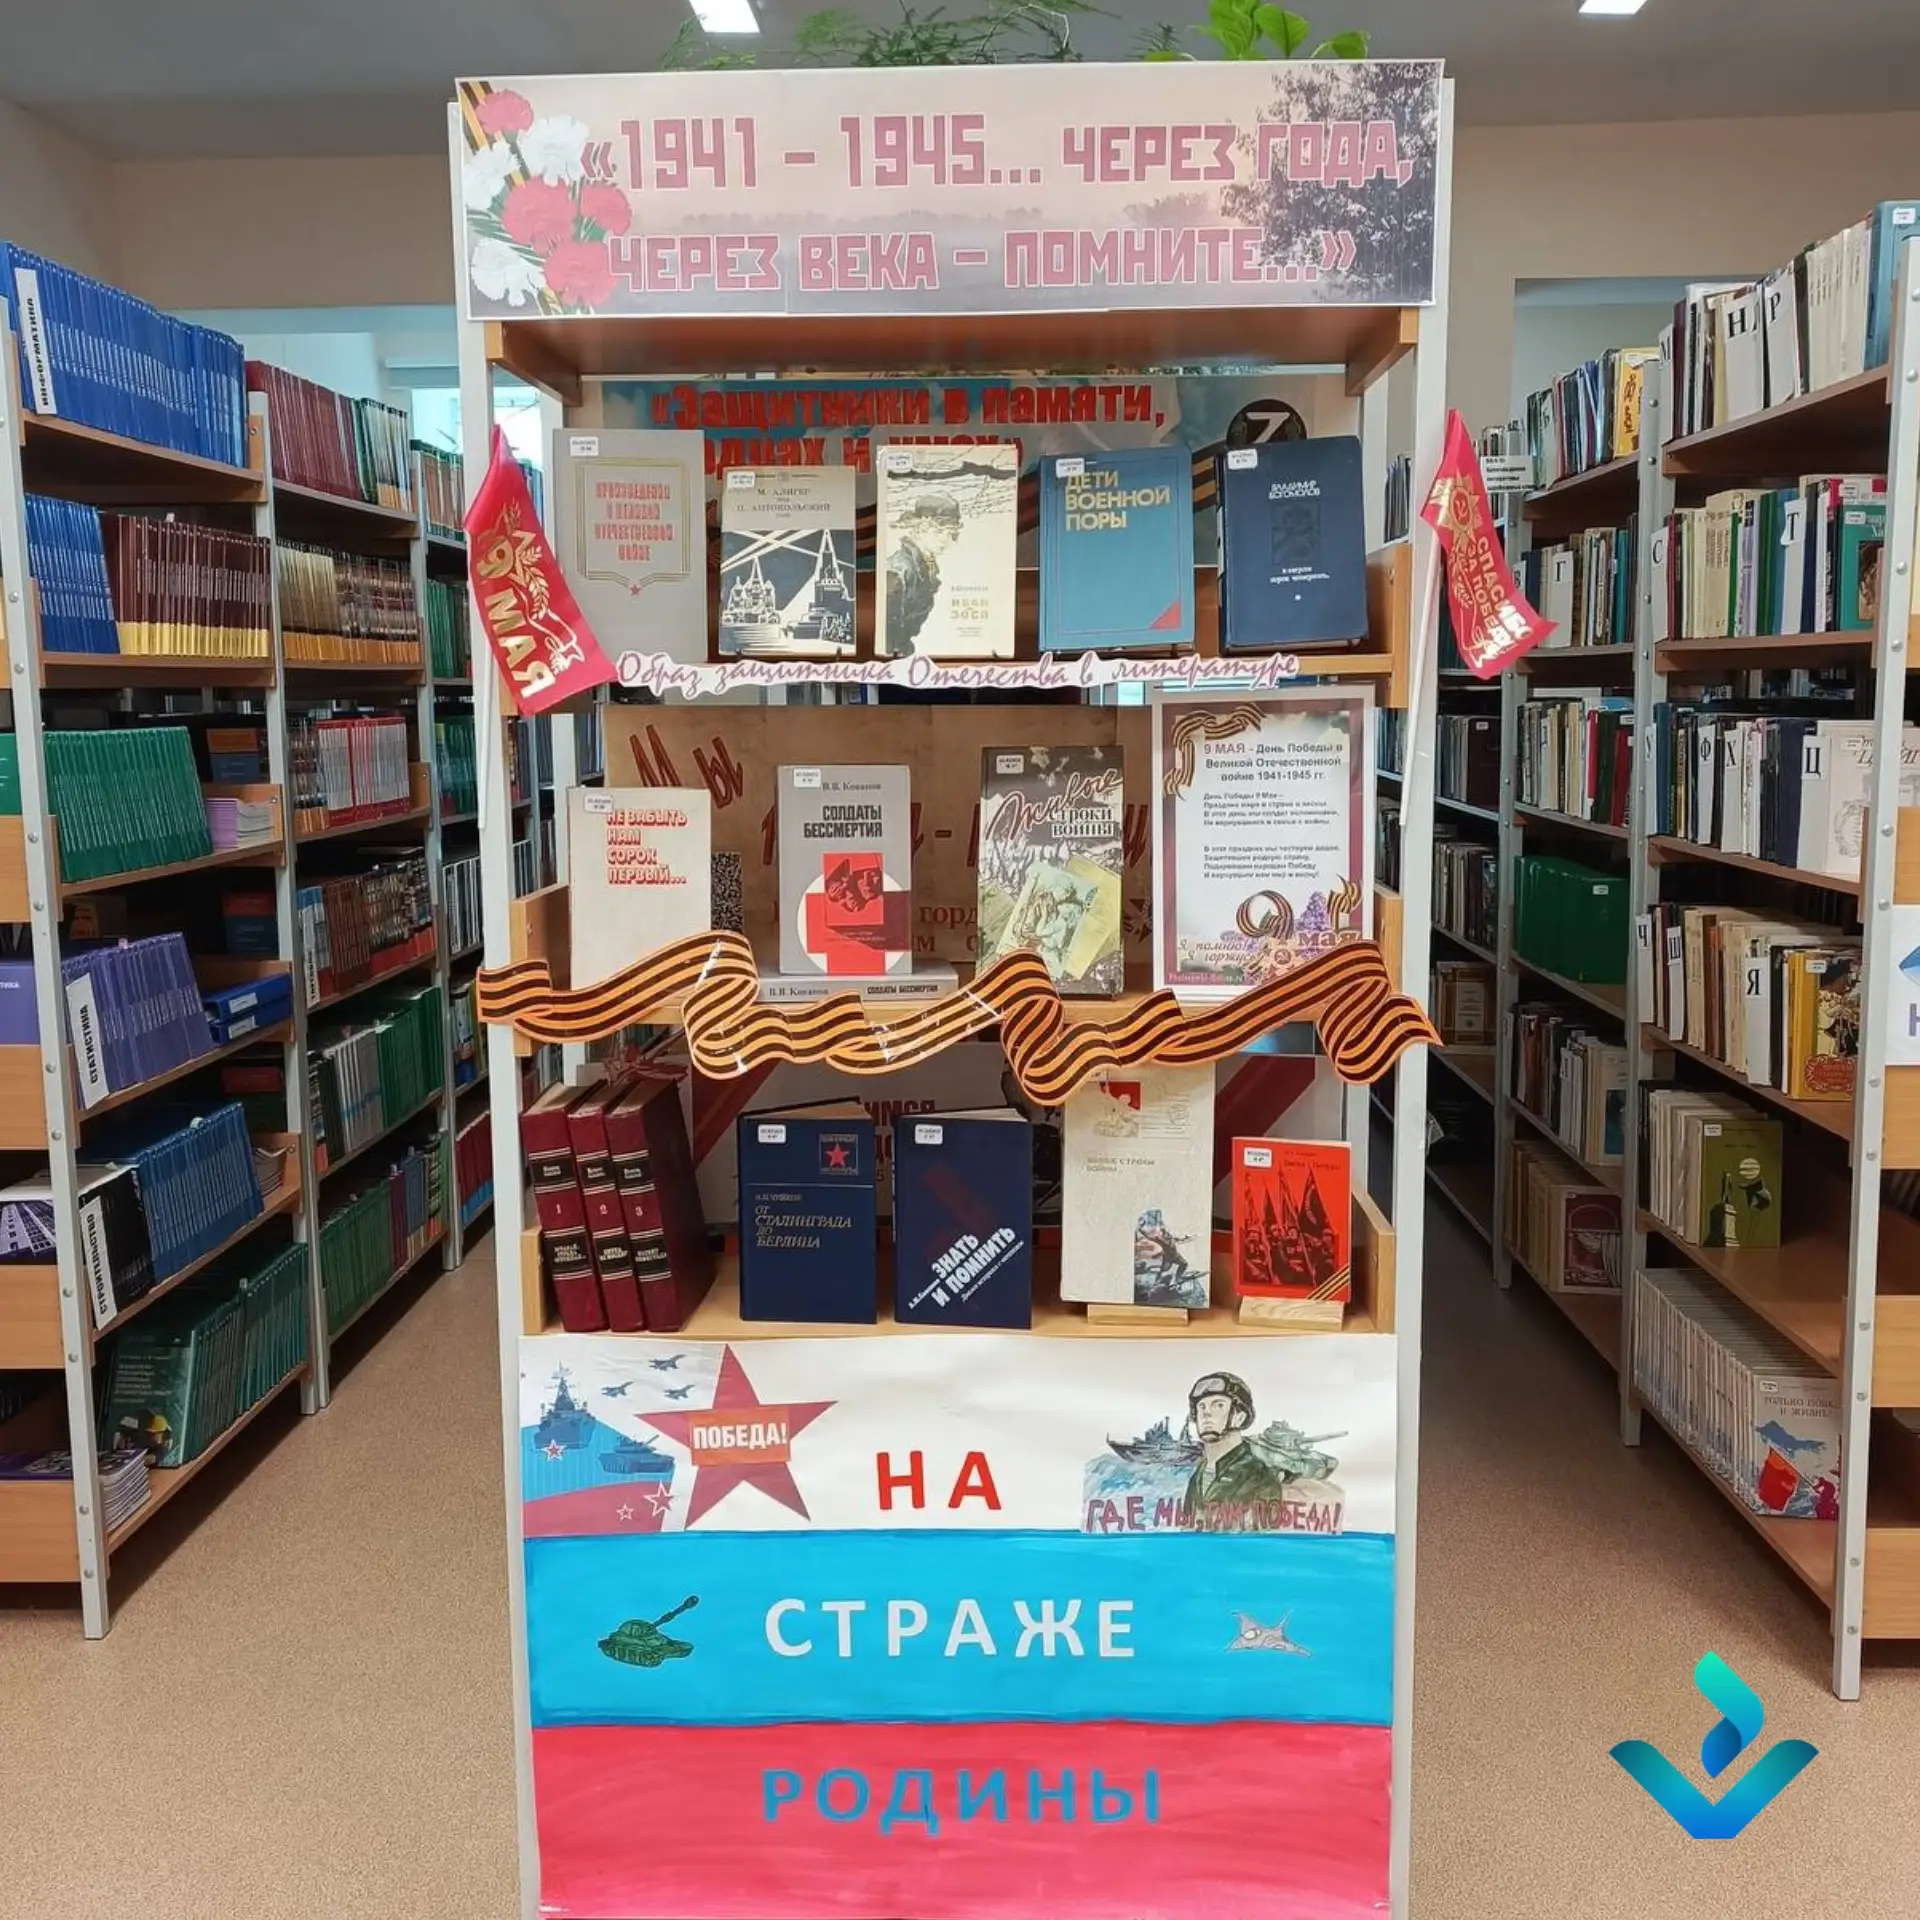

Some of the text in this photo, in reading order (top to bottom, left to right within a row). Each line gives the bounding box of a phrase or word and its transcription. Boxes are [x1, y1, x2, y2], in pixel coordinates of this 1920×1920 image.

[580, 115, 758, 191] «1941
[839, 112, 1042, 189] 1945...
[1062, 123, 1237, 184] ЧЕРЕЗ
[1256, 120, 1413, 188] ГОДА,
[607, 233, 781, 292] ЧЕРЕЗ
[799, 231, 939, 291] ВЕКА
[1004, 227, 1358, 288] ПОМНИТЕ...»
[1770, 291, 1781, 323] Р
[1727, 307, 1747, 339] Н
[25, 297, 49, 408] ИНФОРМАТИКА
[652, 384, 931, 431] «Защитники
[982, 384, 1165, 428] памяти,
[1068, 471, 1118, 493] ДЕТИ
[1065, 485, 1170, 511] ВОЕННОЙ
[1066, 510, 1127, 532] ПОРЫ
[1786, 511, 1800, 541] Т
[476, 536, 514, 579] 9
[1652, 538, 1664, 565] С
[1555, 559, 1567, 583] Г
[484, 587, 556, 698] МАЯ
[619, 653, 702, 699] Образ
[715, 662, 894, 694] защитника
[908, 653, 1068, 687] Отечества
[1110, 652, 1298, 691] литературе
[1215, 743, 1246, 755] МАЯ
[1256, 744, 1285, 755] День
[1287, 743, 1333, 754] Победы
[1700, 737, 1711, 763] Ф
[1726, 740, 1737, 768] Х
[1804, 746, 1822, 777] Ц
[1206, 756, 1341, 769] Великой Отечественной
[1221, 772, 1255, 782] войне
[1258, 771, 1312, 781] 1941-1945
[607, 809, 688, 827] НЕ ЗАБЫТЬ
[822, 804, 883, 821] СОЛДАТЫ
[606, 829, 642, 846] НАМ
[803, 822, 883, 839] БЕССМЕРТИЯ
[606, 847, 658, 865] СОРОК
[608, 864, 687, 885] ПЕРВЫЙ...
[1638, 924, 1648, 948] Ч
[1669, 936, 1681, 961] Ш
[1747, 968, 1760, 996] Я
[78, 1003, 99, 1085] СТАТИСТИКА
[555, 1203, 562, 1215] 1
[600, 1203, 608, 1215] 2
[635, 1205, 643, 1216] 3
[755, 1205, 770, 1215] ОТ
[755, 1215, 852, 1228] СТАЛИНГРАДА
[756, 1226, 773, 1236] ДО
[756, 1235, 821, 1248] БЕРЛИНА
[86, 1211, 109, 1316] СТРОИТЕЛЬСТВО
[930, 1227, 1016, 1308] И ПОМНИТЬ
[931, 1234, 980, 1280] ЗНАТЬ
[691, 1420, 789, 1453] ПОБЕДА!
[876, 1451, 1003, 1512] НА
[1086, 1496, 1146, 1534] ГДЕ
[1203, 1499, 1244, 1531] ТАМ
[1252, 1497, 1342, 1534] ПОБЕДА!
[765, 1598, 1137, 1660] СТРАЖЕ
[762, 1769, 1161, 1836] РОДИНЫ
